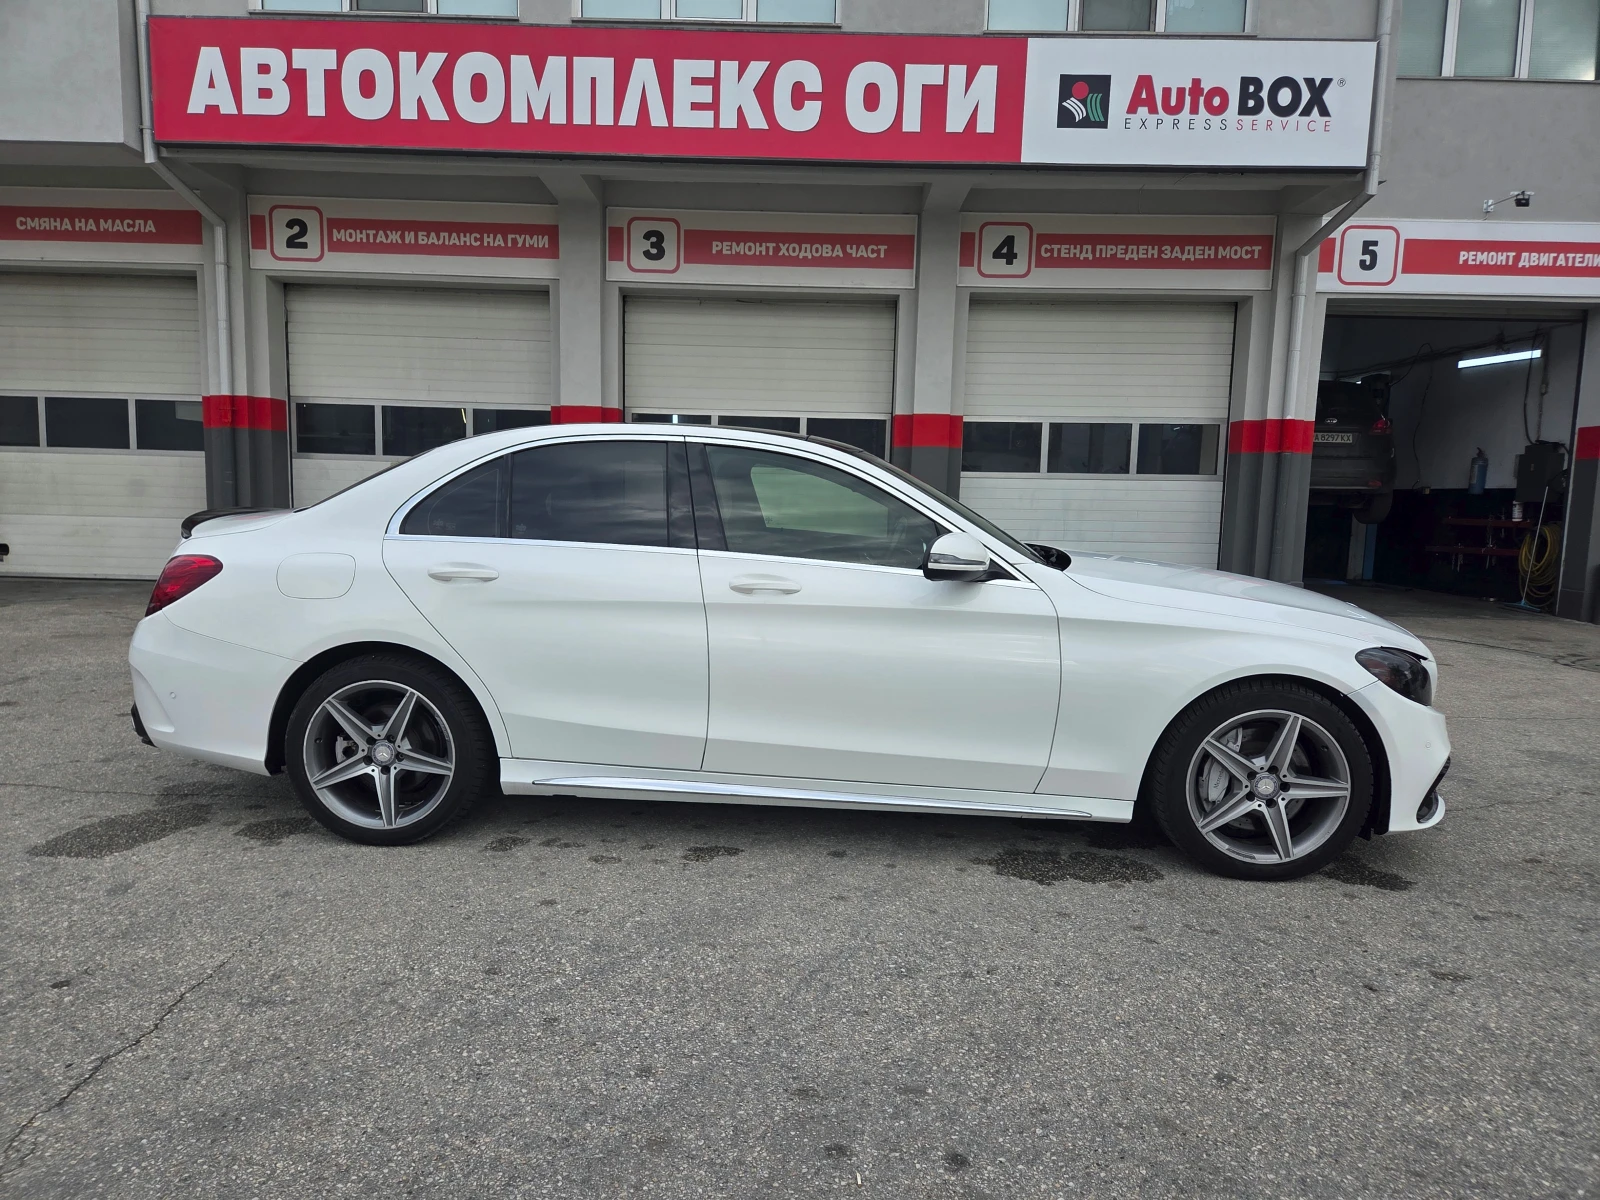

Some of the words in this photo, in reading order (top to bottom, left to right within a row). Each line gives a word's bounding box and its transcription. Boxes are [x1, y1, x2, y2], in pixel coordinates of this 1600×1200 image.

[187, 46, 823, 132] АВТОКОМПЛЕКС
[845, 61, 998, 134] ОГИ
[1125, 74, 1230, 117] Auto
[1237, 76, 1334, 118] BOX
[1124, 118, 1228, 131] EXPRESS
[1236, 119, 1331, 132] SERVICE
[16, 217, 72, 231] СМЯНА
[75, 218, 97, 231] НА
[100, 219, 156, 233] МАСЛА
[284, 218, 309, 250] 2
[332, 229, 402, 243] МОНТАЖ
[404, 231, 415, 245] И
[418, 231, 481, 246] БАЛАНС
[483, 233, 505, 247] НА
[507, 234, 549, 248] ГУМИ
[642, 230, 666, 262] 3
[712, 241, 776, 256] РЕМОНТ
[778, 243, 843, 259] ХОДОВА
[846, 245, 887, 258] ЧАСТ
[992, 234, 1018, 266] 4
[1040, 244, 1093, 260] СТЕНД
[1095, 245, 1158, 261] ПРЕДЕН
[1161, 246, 1214, 261] ЗАДЕН
[1217, 246, 1262, 259] МОСТ
[1359, 240, 1379, 271] 5
[1459, 251, 1516, 265] РЕМОНТ
